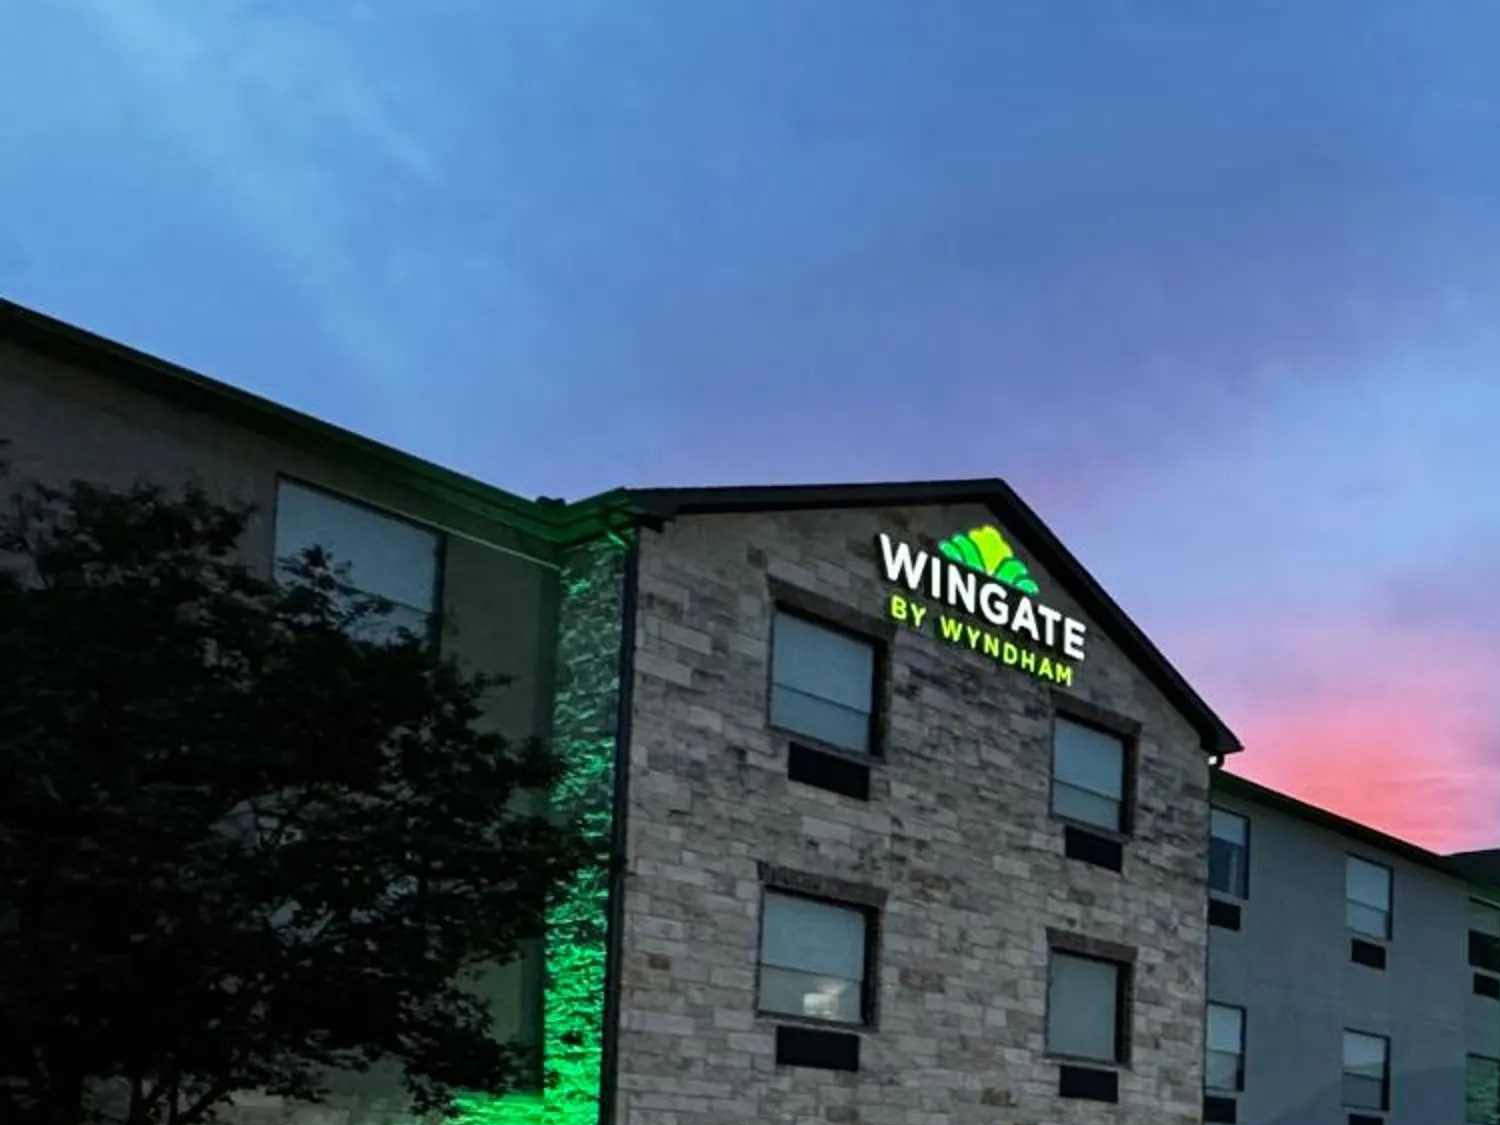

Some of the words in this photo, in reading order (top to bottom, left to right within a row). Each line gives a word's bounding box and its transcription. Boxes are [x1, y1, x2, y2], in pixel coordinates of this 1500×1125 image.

[880, 533, 1086, 661] WINGATE
[890, 594, 927, 628] BY
[940, 615, 1073, 687] WYNDHAM
